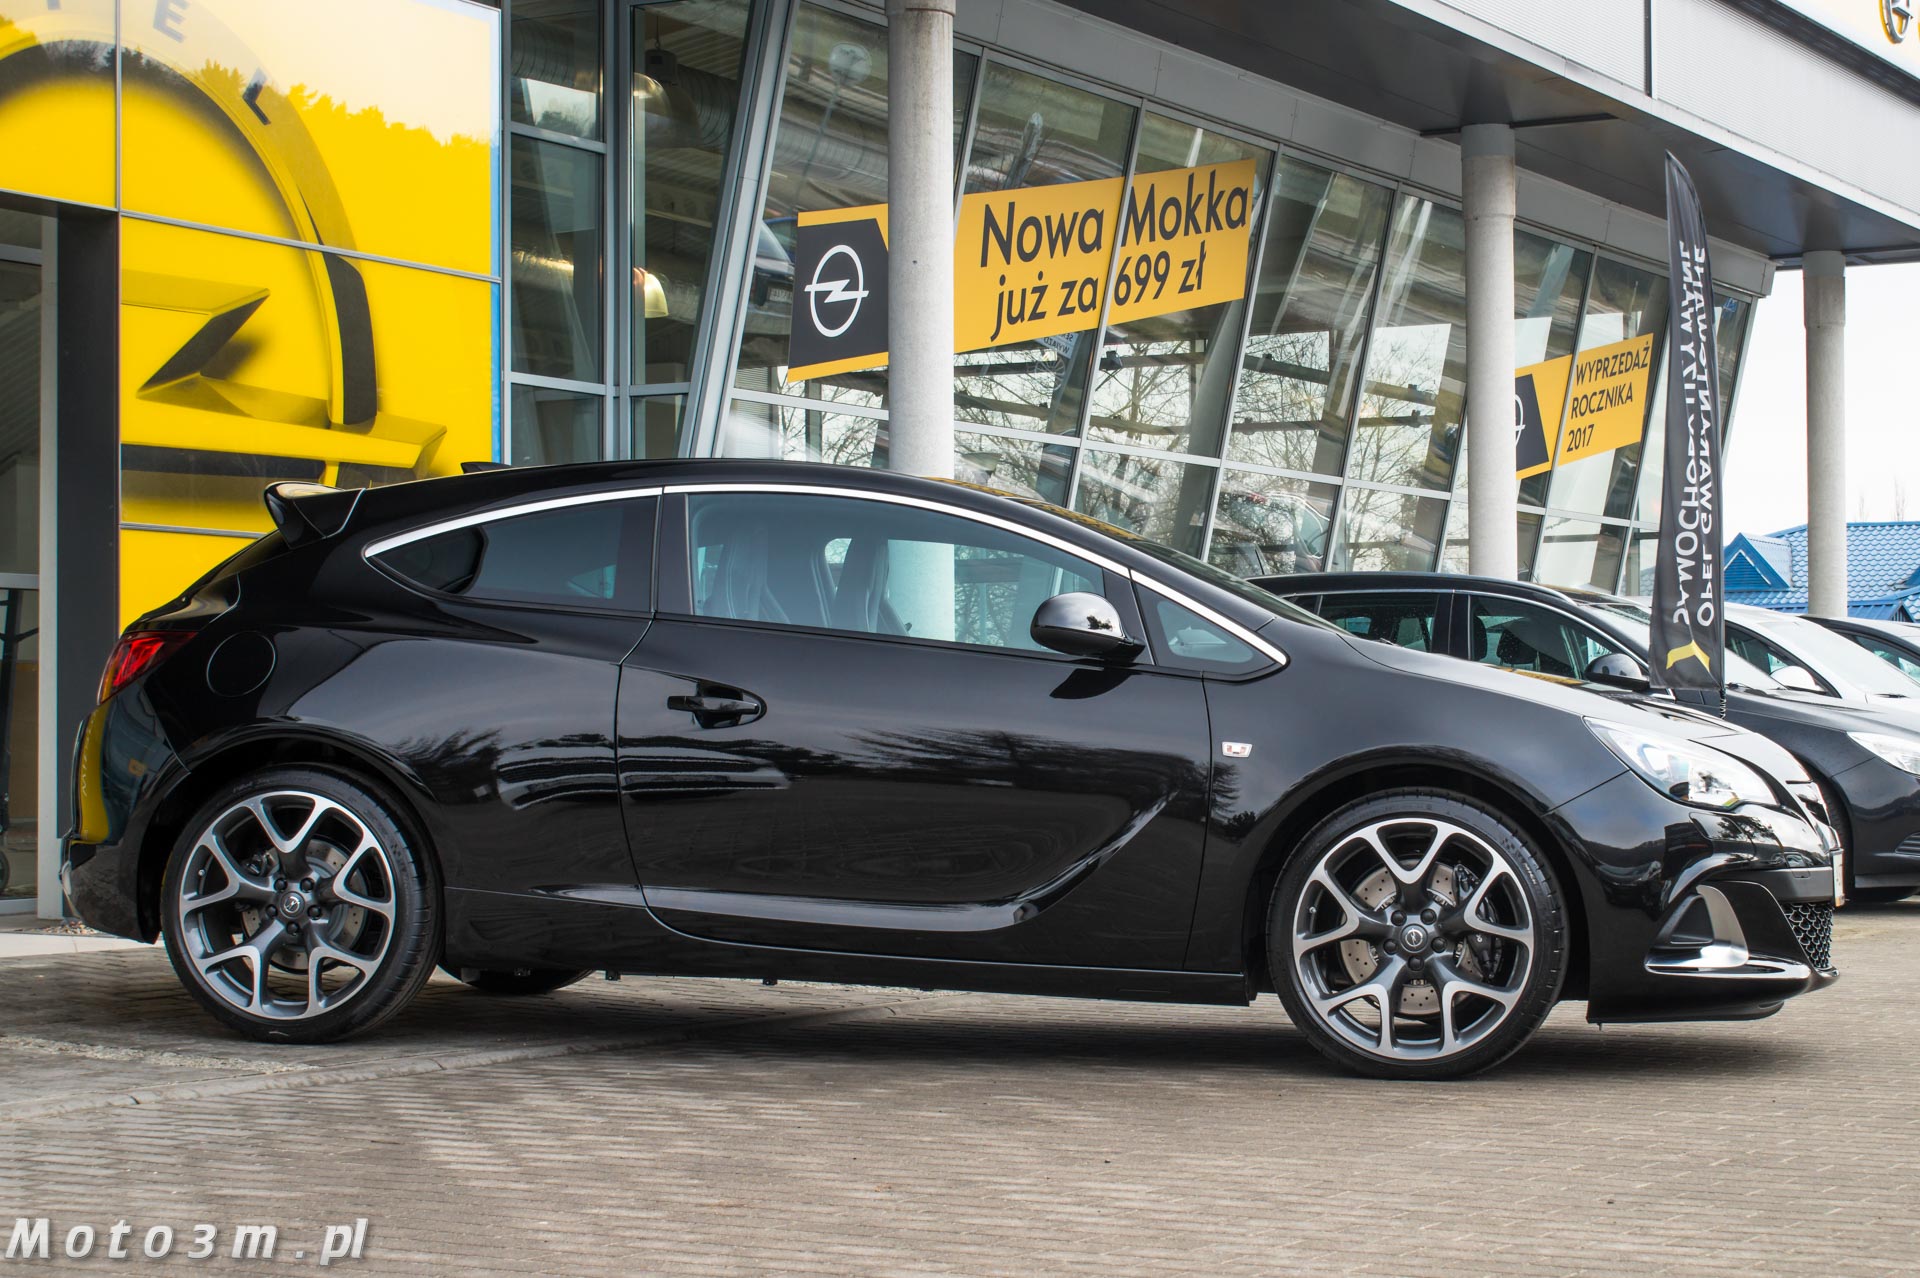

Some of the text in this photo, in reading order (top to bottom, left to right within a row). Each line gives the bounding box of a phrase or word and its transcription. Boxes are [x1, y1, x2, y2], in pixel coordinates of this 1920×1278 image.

[980, 169, 1249, 268] Nowa Mokka
[990, 240, 1207, 342] już za 699 zł
[1576, 341, 1651, 386] WYPRZEDAŻ
[1571, 382, 1633, 419] ROCZNIKA
[1566, 424, 1595, 453] 2017
